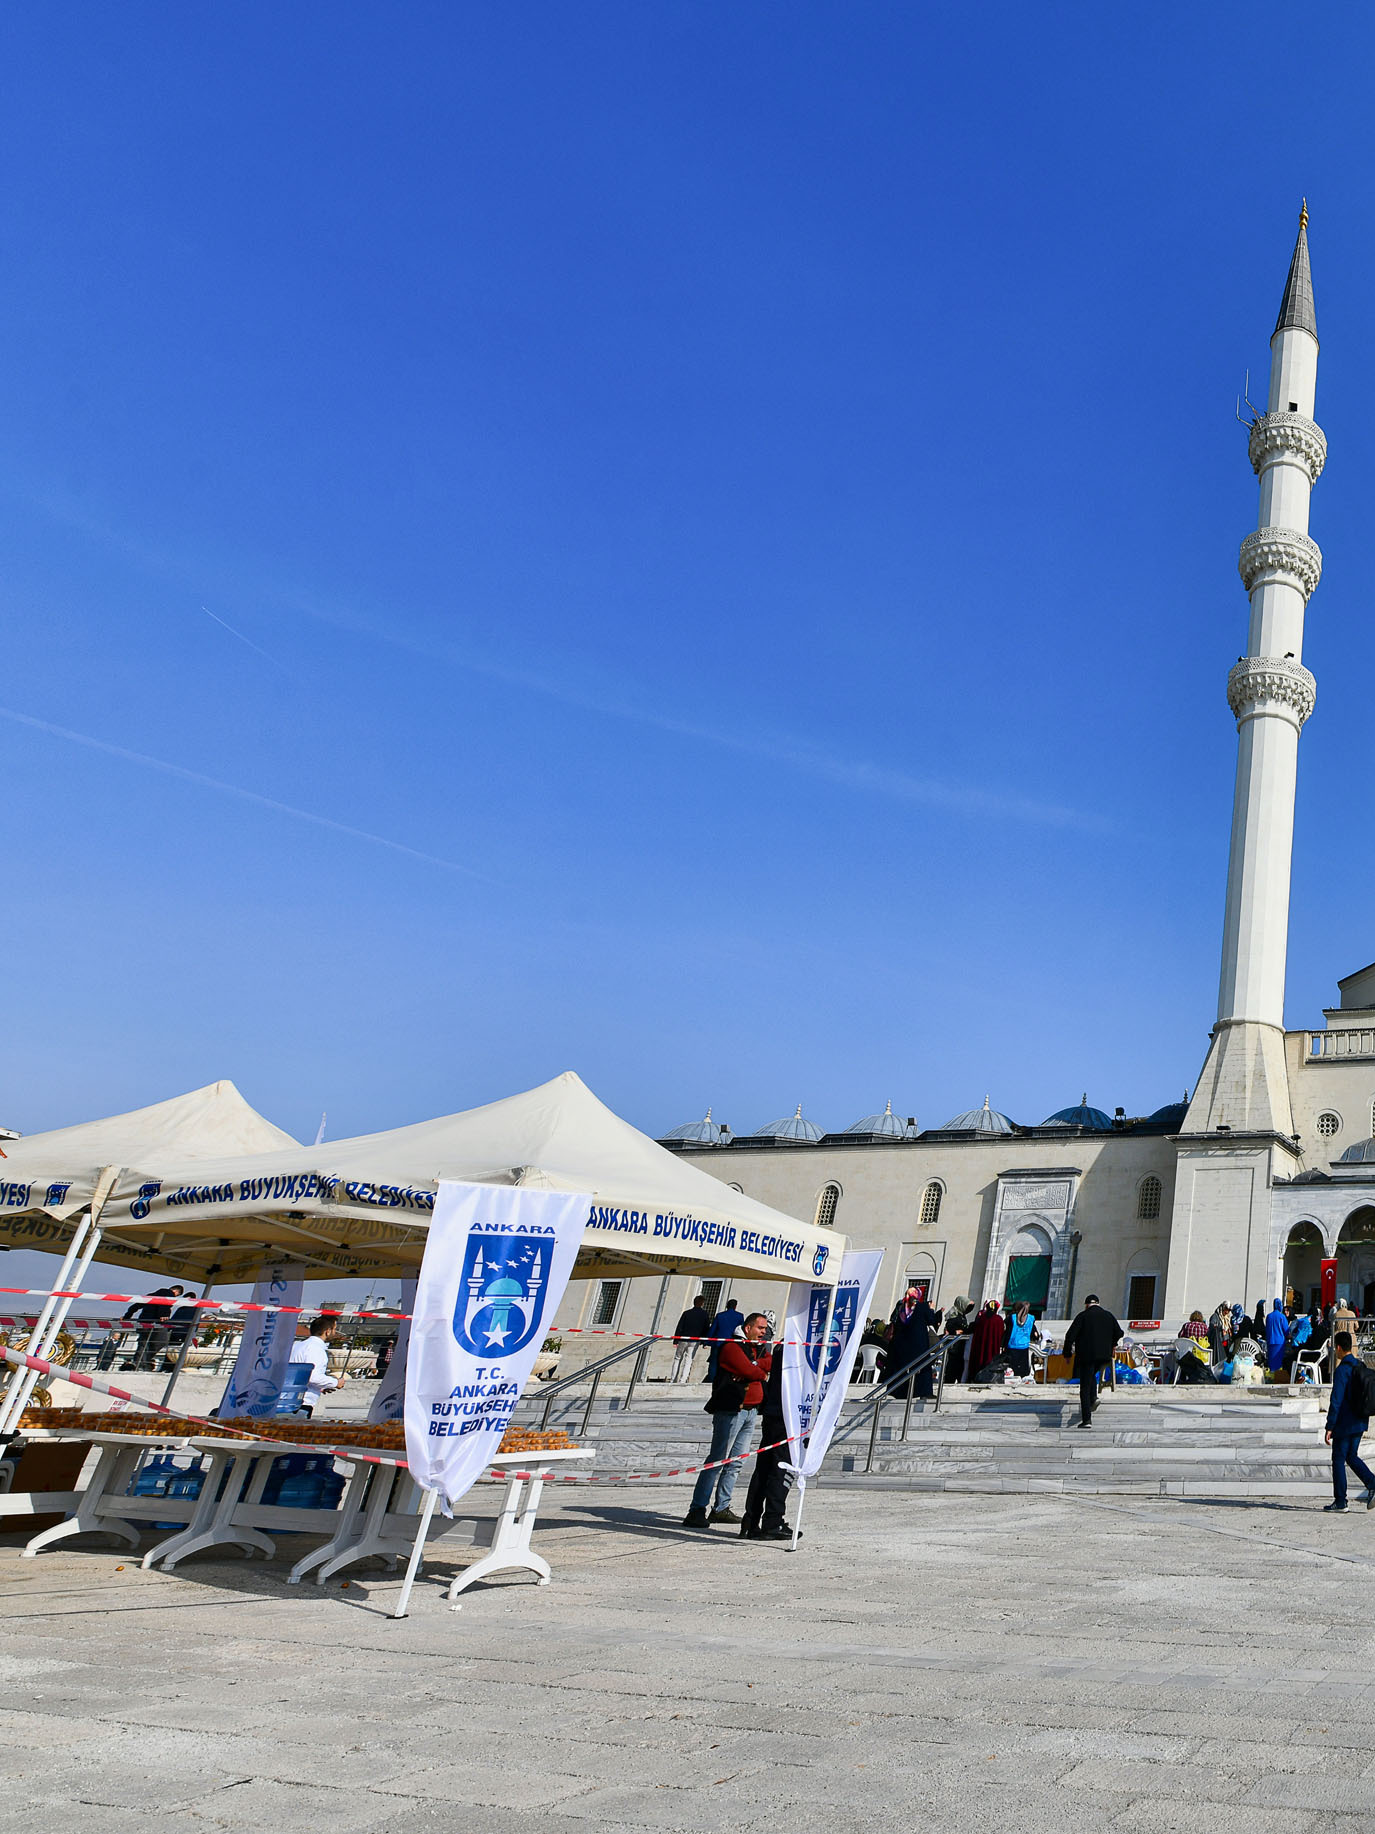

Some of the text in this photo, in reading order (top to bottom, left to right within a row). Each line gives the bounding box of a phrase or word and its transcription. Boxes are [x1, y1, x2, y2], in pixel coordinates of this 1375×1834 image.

[345, 1181, 437, 1210] BELEDİYES
[469, 1222, 555, 1235] ANKARA
[585, 1205, 649, 1235] ANKARA
[653, 1211, 737, 1248] BÜYÜKŞEHİR
[739, 1228, 805, 1263] BELEDİYESİ
[475, 1367, 505, 1380] T.C.
[449, 1383, 518, 1399] ANKARA
[429, 1417, 511, 1437] BELEDİYE
